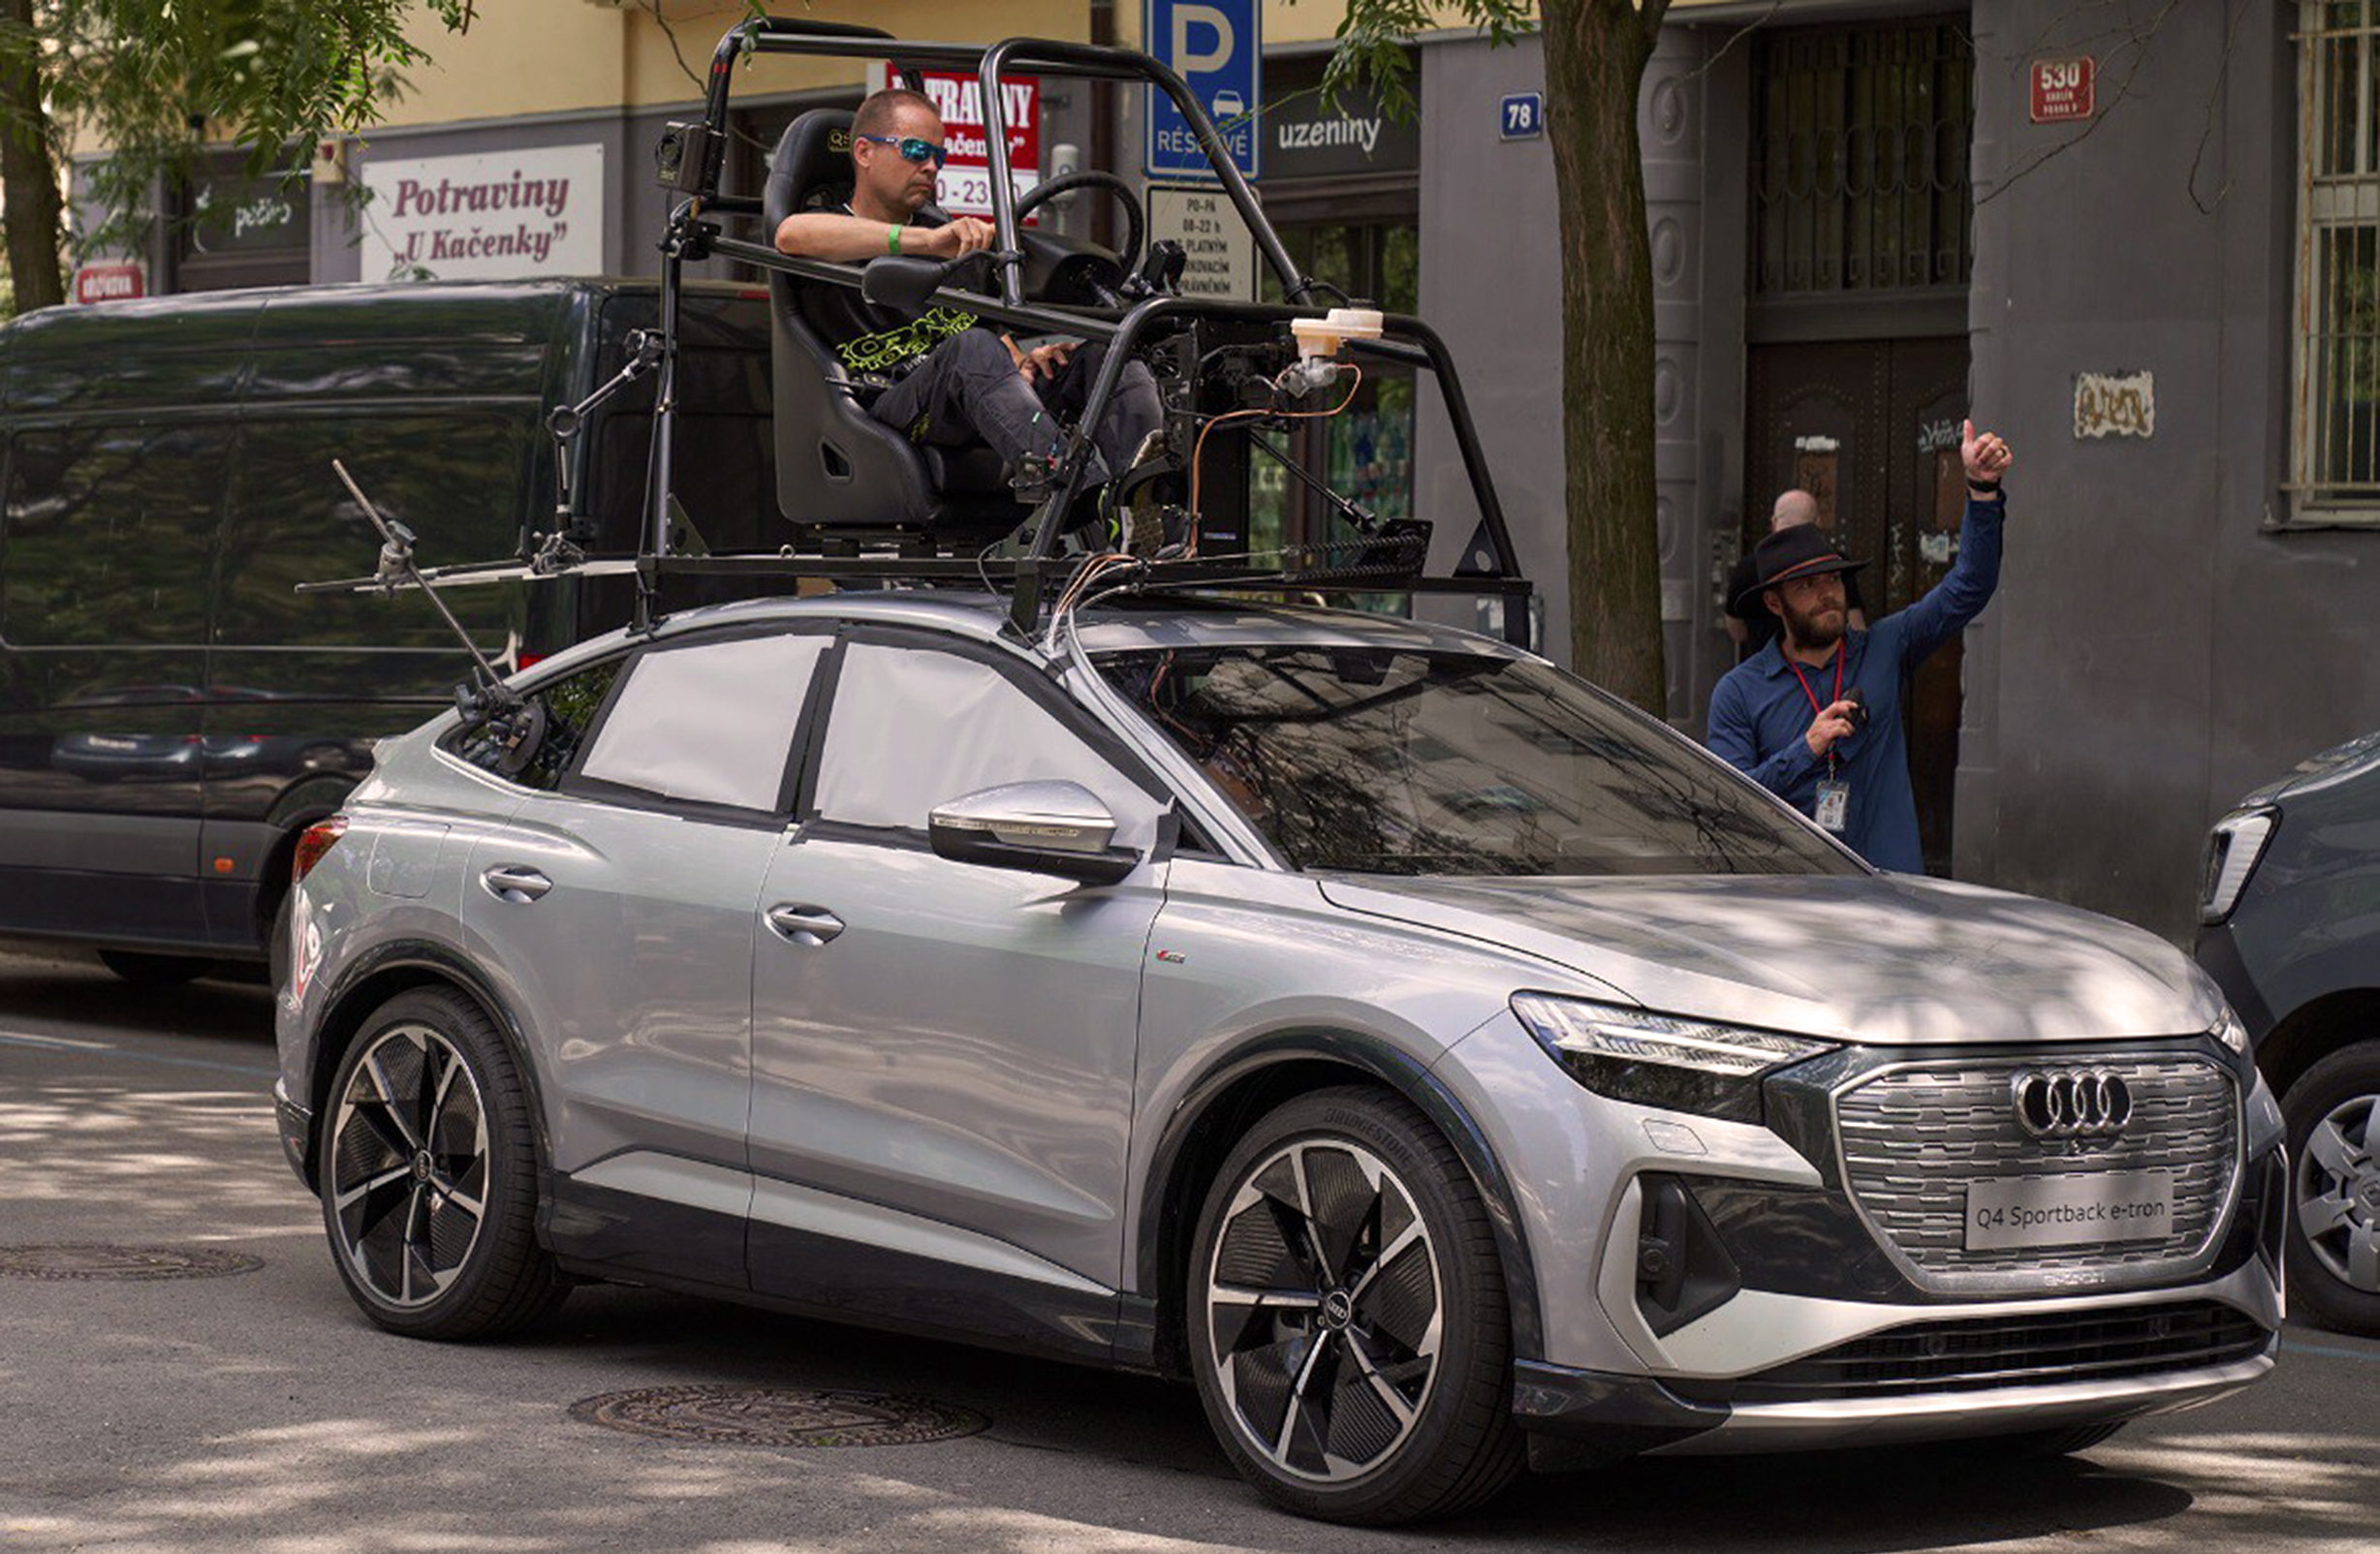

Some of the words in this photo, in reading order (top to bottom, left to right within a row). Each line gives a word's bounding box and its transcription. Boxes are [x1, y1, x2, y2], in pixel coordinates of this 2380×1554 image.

[1172, 4, 1235, 113] P
[2041, 64, 2080, 90] 530
[1508, 104, 1531, 129] 78
[1157, 126, 1248, 157] RÉSVÉ
[1278, 117, 1382, 152] uzeniny
[392, 170, 570, 218] Potraviny
[1977, 1209, 2004, 1228] Q4
[2010, 1202, 2108, 1228] Sportback
[2111, 1201, 2165, 1219] e-tron
